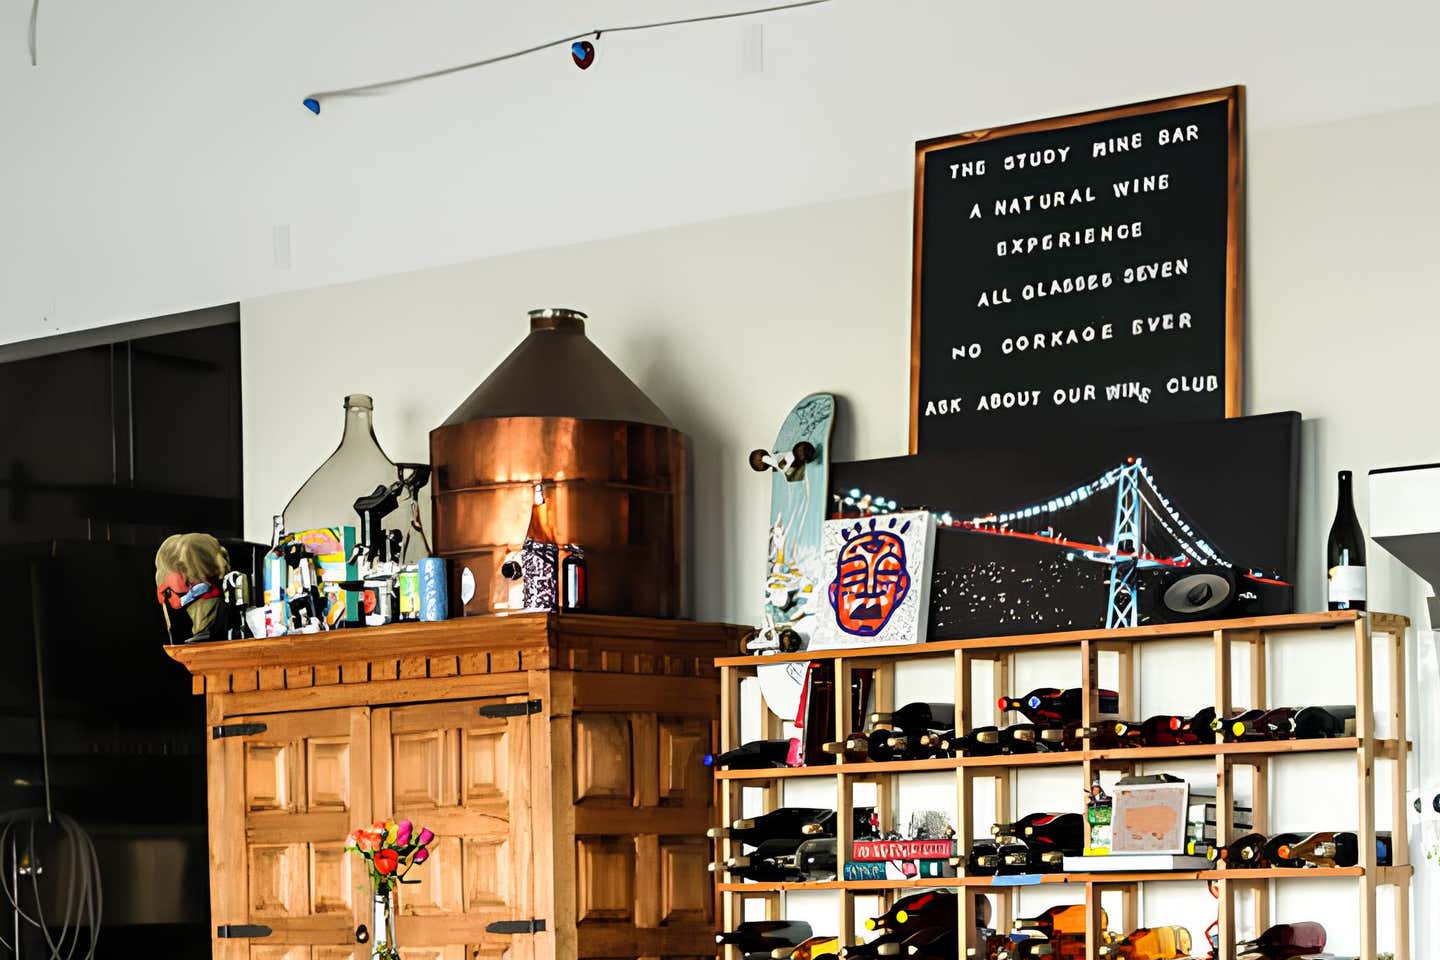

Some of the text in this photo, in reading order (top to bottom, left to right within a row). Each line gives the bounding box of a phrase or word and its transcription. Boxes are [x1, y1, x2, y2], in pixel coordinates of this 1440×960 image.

[1158, 124, 1199, 146] BAR
[969, 174, 1169, 219] A NATURAL WINE
[977, 288, 1012, 308] ALL
[951, 343, 982, 360] NO
[1132, 312, 1192, 336] EVER
[976, 390, 1041, 411] ABOUT
[1052, 384, 1096, 406] OUR
